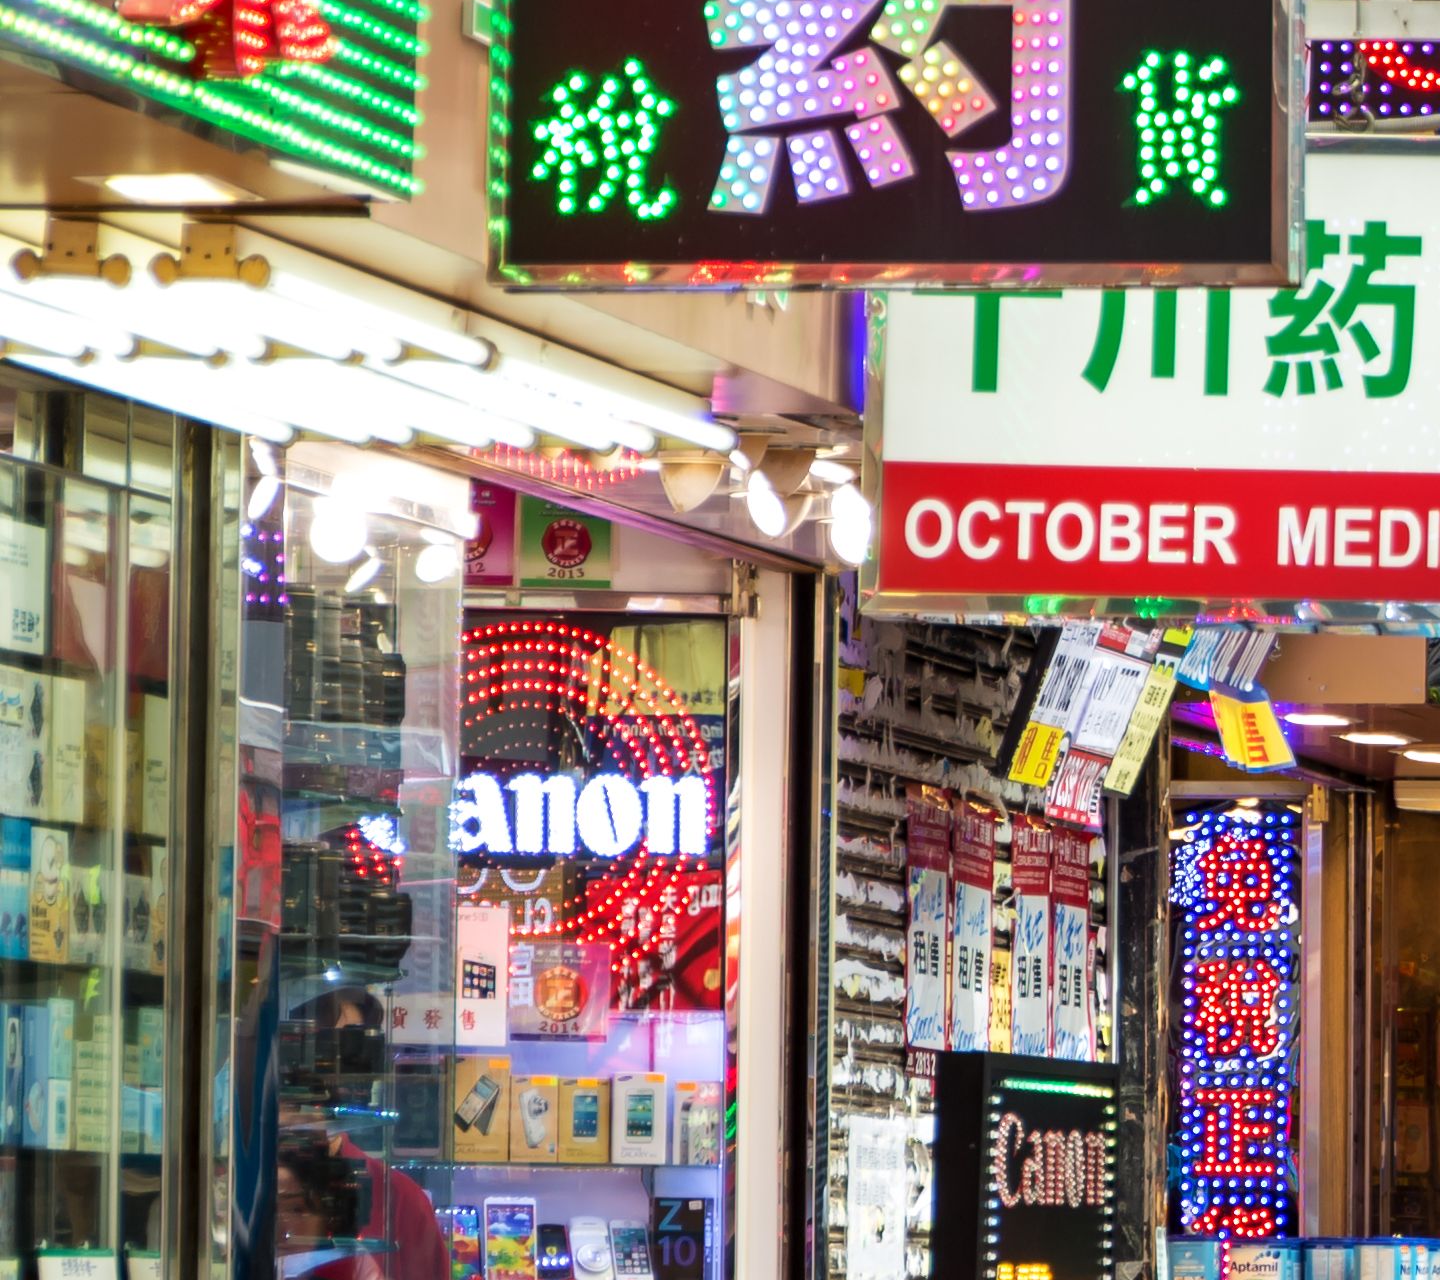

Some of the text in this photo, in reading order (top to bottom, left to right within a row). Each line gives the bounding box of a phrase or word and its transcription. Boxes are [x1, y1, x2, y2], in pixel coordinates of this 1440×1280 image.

[902, 498, 1238, 567] OCTOBER
[538, 1019, 581, 1036] 2014
[996, 1110, 1108, 1208] Canon
[658, 1199, 683, 1232] Z
[658, 1233, 697, 1268] 10
[1230, 1261, 1279, 1274] Aptamil
